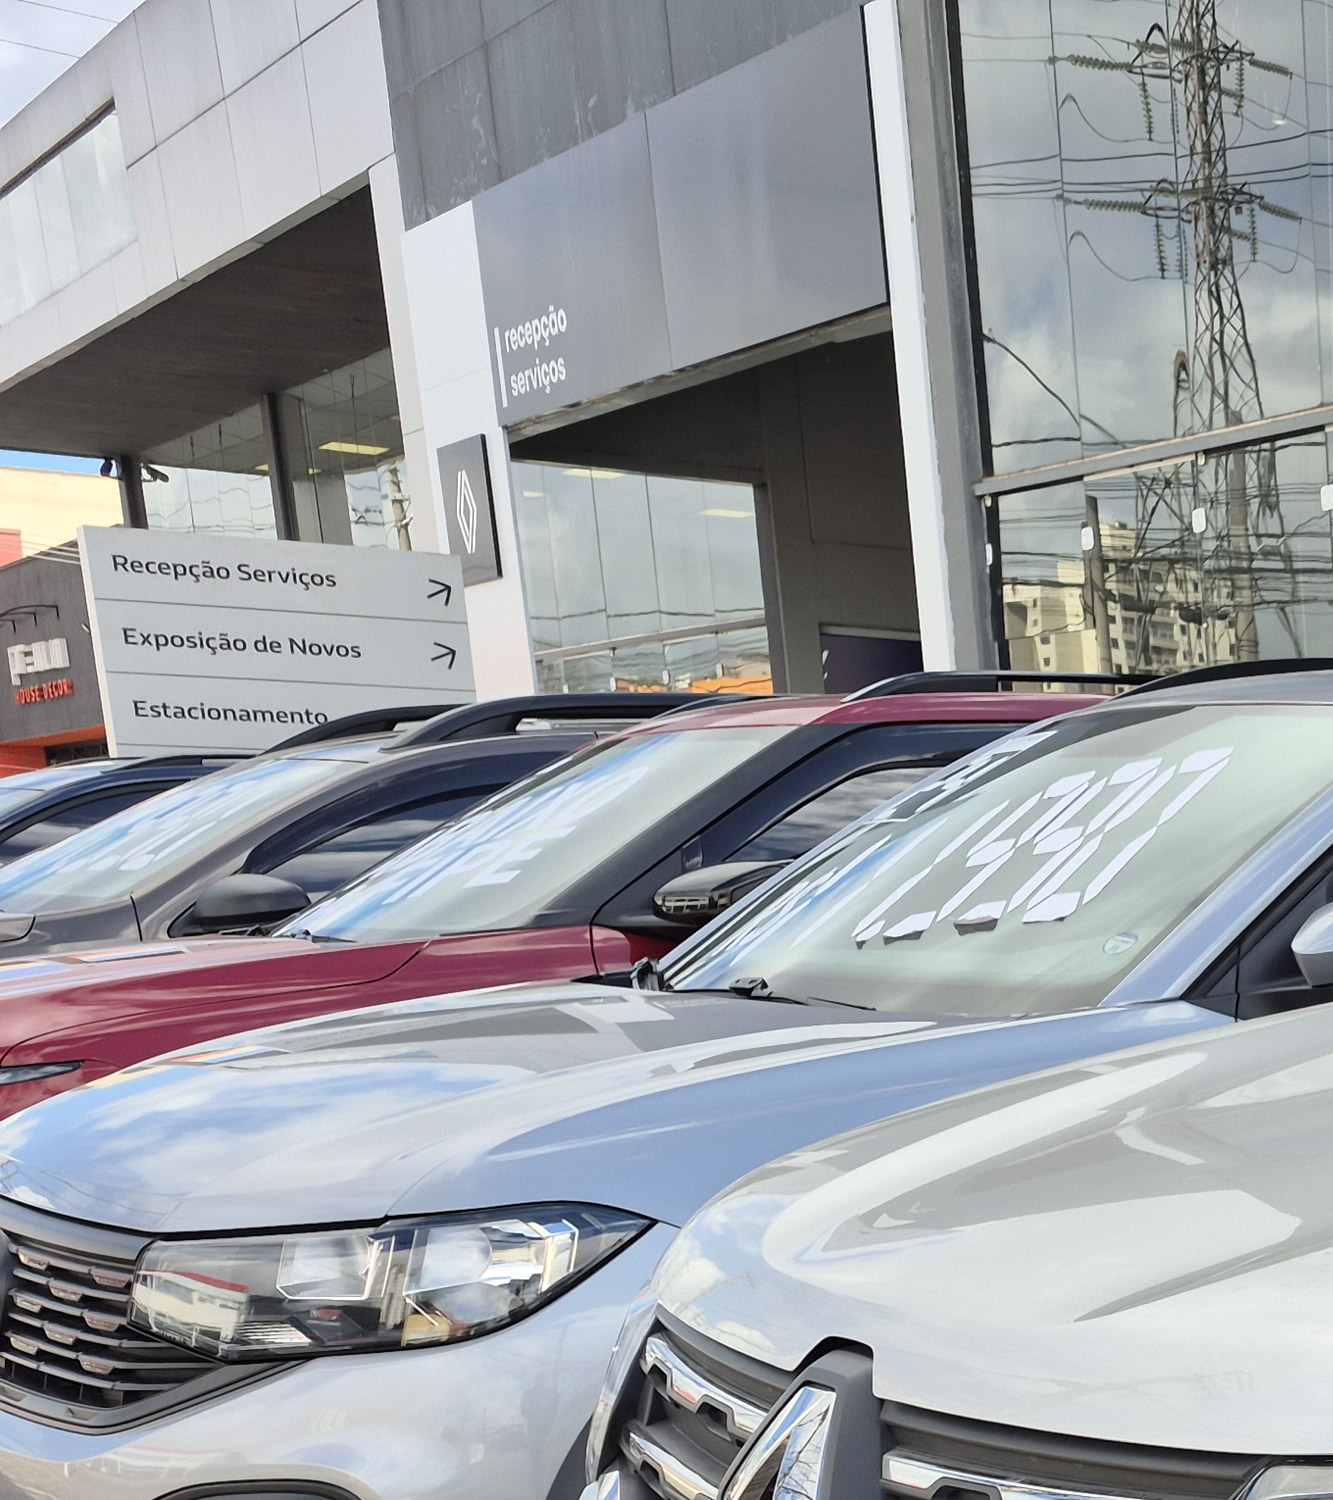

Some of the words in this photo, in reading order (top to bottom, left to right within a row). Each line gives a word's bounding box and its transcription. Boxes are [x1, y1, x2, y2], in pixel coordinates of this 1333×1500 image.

[504, 304, 567, 353] recepção
[510, 357, 567, 397] serviços
[111, 552, 231, 584] Recepção
[236, 563, 337, 590] Serviços
[121, 626, 247, 656] Exposição
[253, 634, 282, 654] de
[288, 636, 362, 659] Novos
[132, 699, 329, 727] Estacionamento
